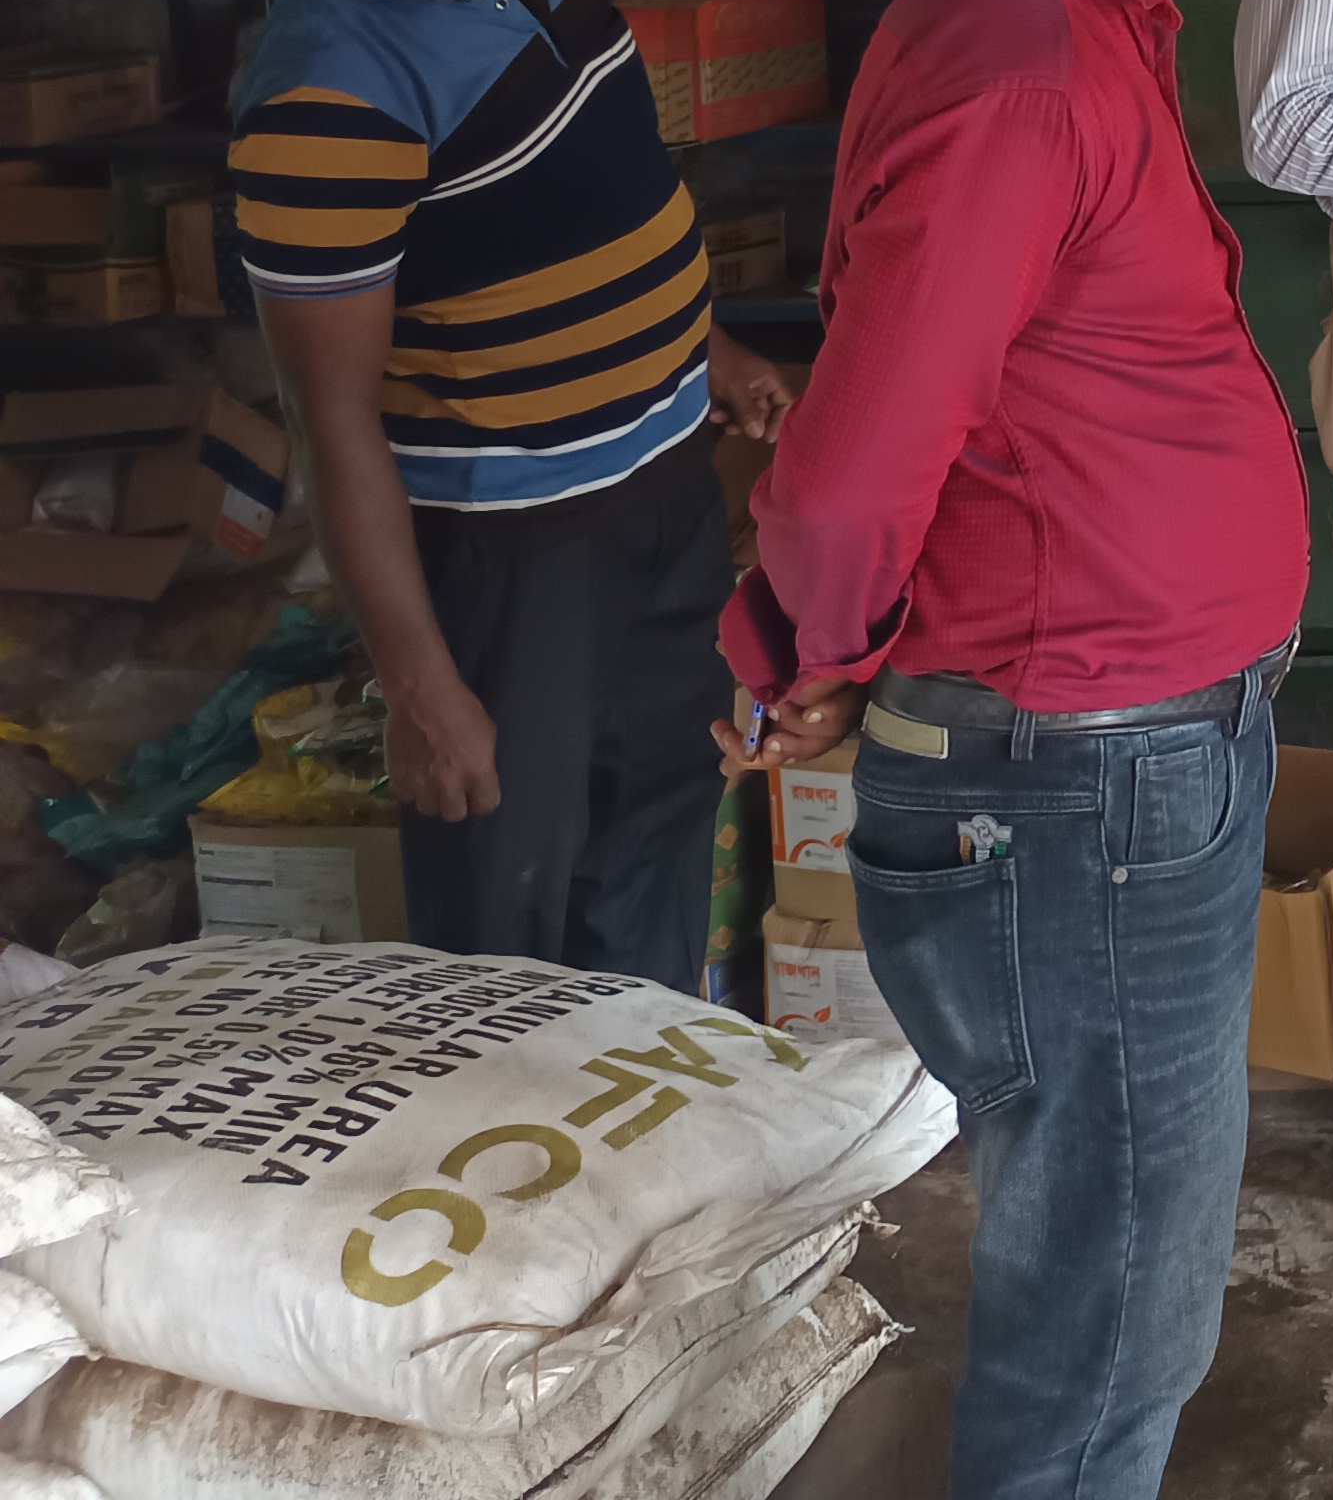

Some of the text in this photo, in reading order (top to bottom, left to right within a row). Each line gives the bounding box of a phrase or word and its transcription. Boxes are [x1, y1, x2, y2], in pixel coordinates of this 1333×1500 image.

[242, 952, 353, 981] USE
[242, 953, 437, 1020] MOISTURE
[366, 963, 502, 1012] BIURET
[174, 987, 262, 1017] NO
[199, 969, 568, 1155] NITROGEN 46% MIN
[242, 976, 647, 1187] GRANULAR UREA
[57, 1076, 182, 1141] MAX
[137, 1065, 275, 1141] MAX
